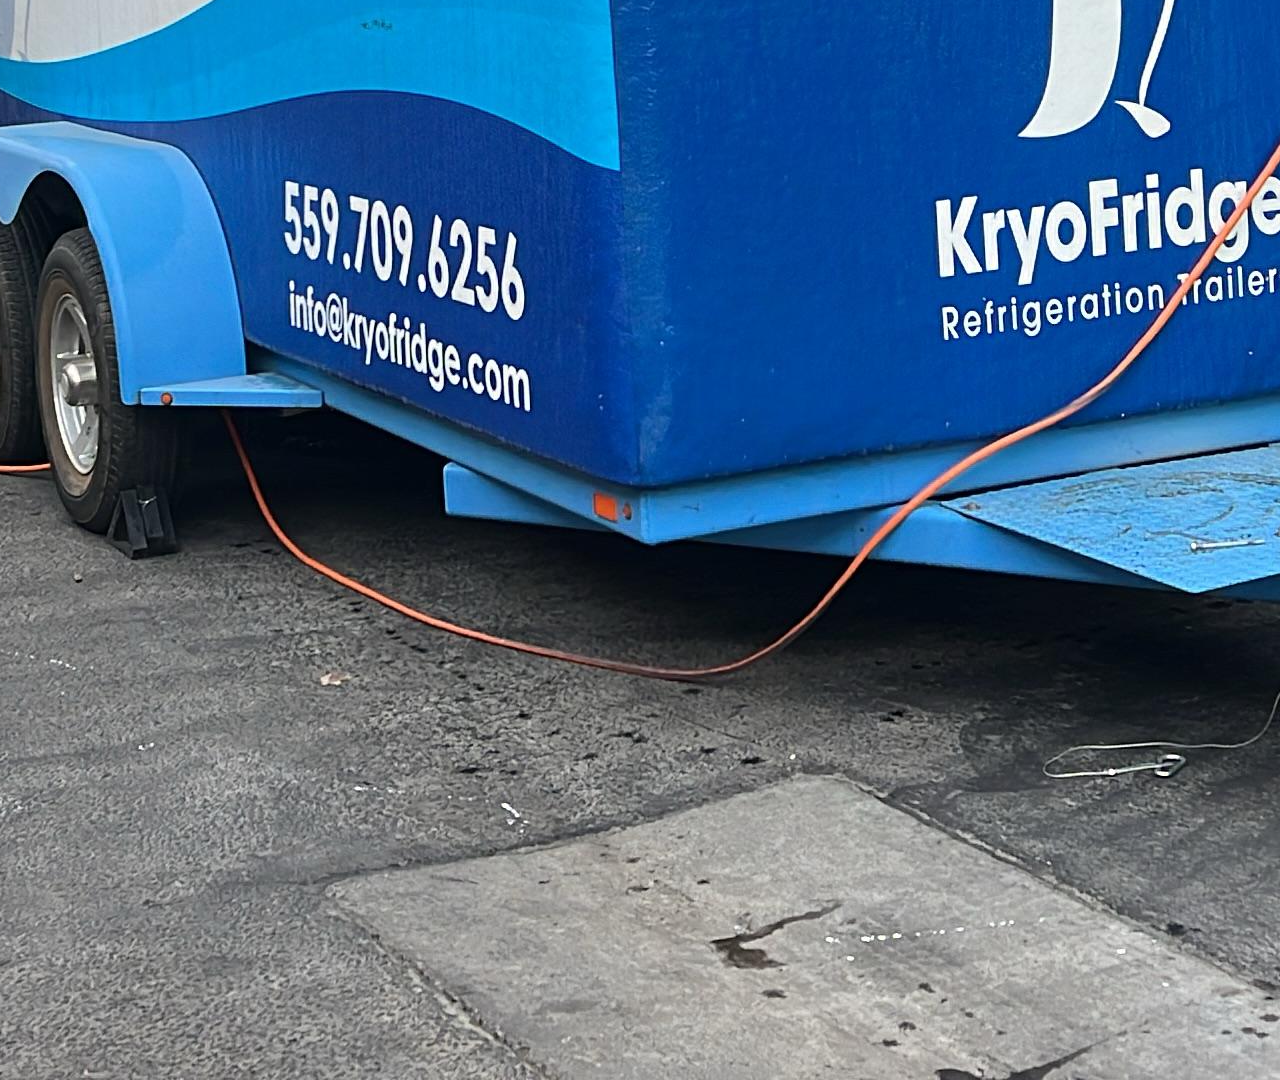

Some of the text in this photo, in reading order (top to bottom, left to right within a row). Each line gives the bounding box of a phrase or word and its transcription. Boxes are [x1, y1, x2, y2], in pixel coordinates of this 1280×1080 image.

[284, 180, 525, 320] 559.709.6256
[941, 281, 1164, 340] Refrigeration
[288, 280, 531, 412] info@kryofridge.com
